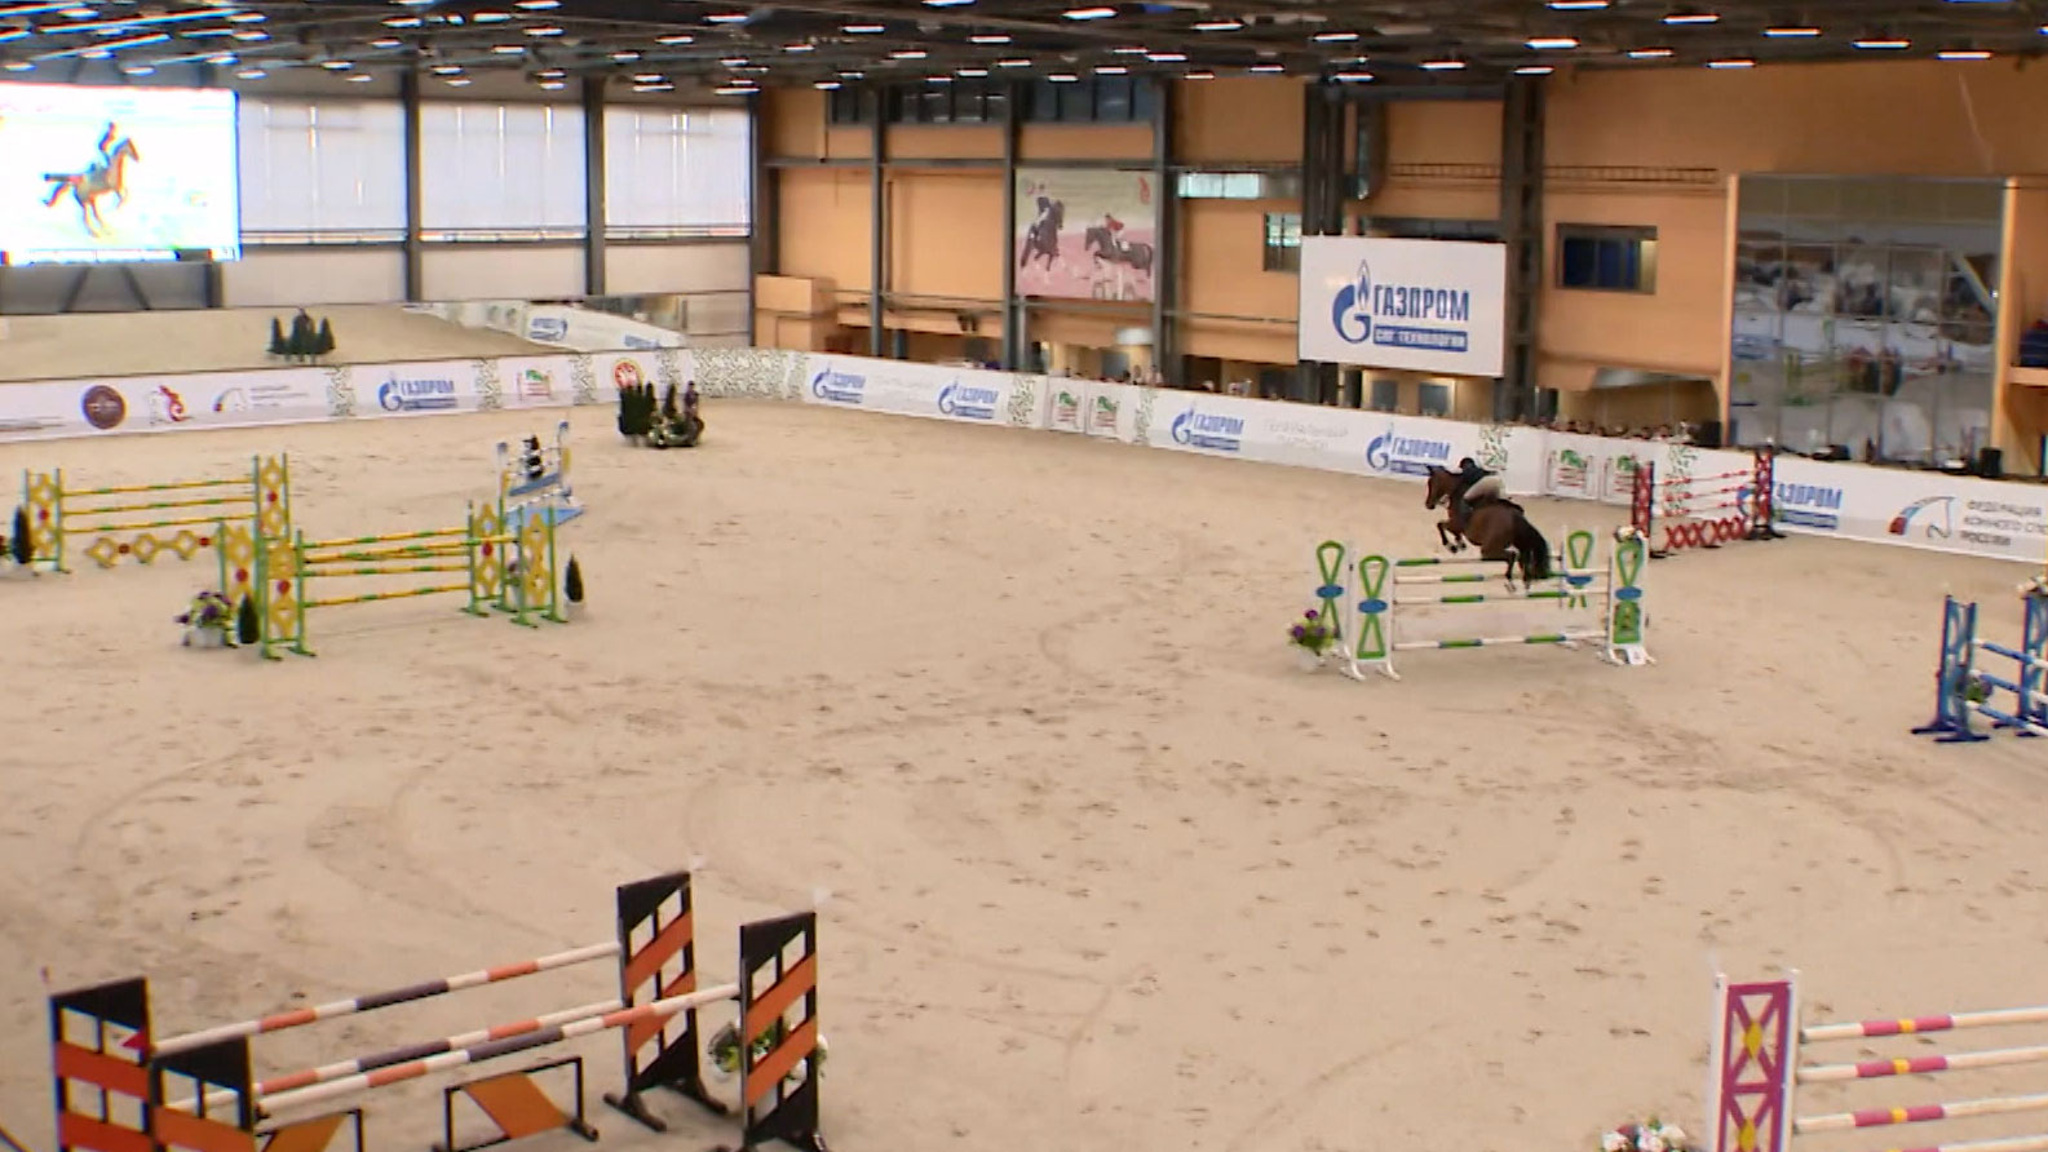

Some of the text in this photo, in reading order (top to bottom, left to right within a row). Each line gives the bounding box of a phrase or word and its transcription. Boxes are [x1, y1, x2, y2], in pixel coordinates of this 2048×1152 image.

[1374, 284, 1470, 321] ГАЗПРОМ
[1193, 413, 1244, 434] ГАЗПРОМ
[1391, 437, 1450, 460] ГАЗПРОМ
[1773, 482, 1843, 509] АЗПРОМ
